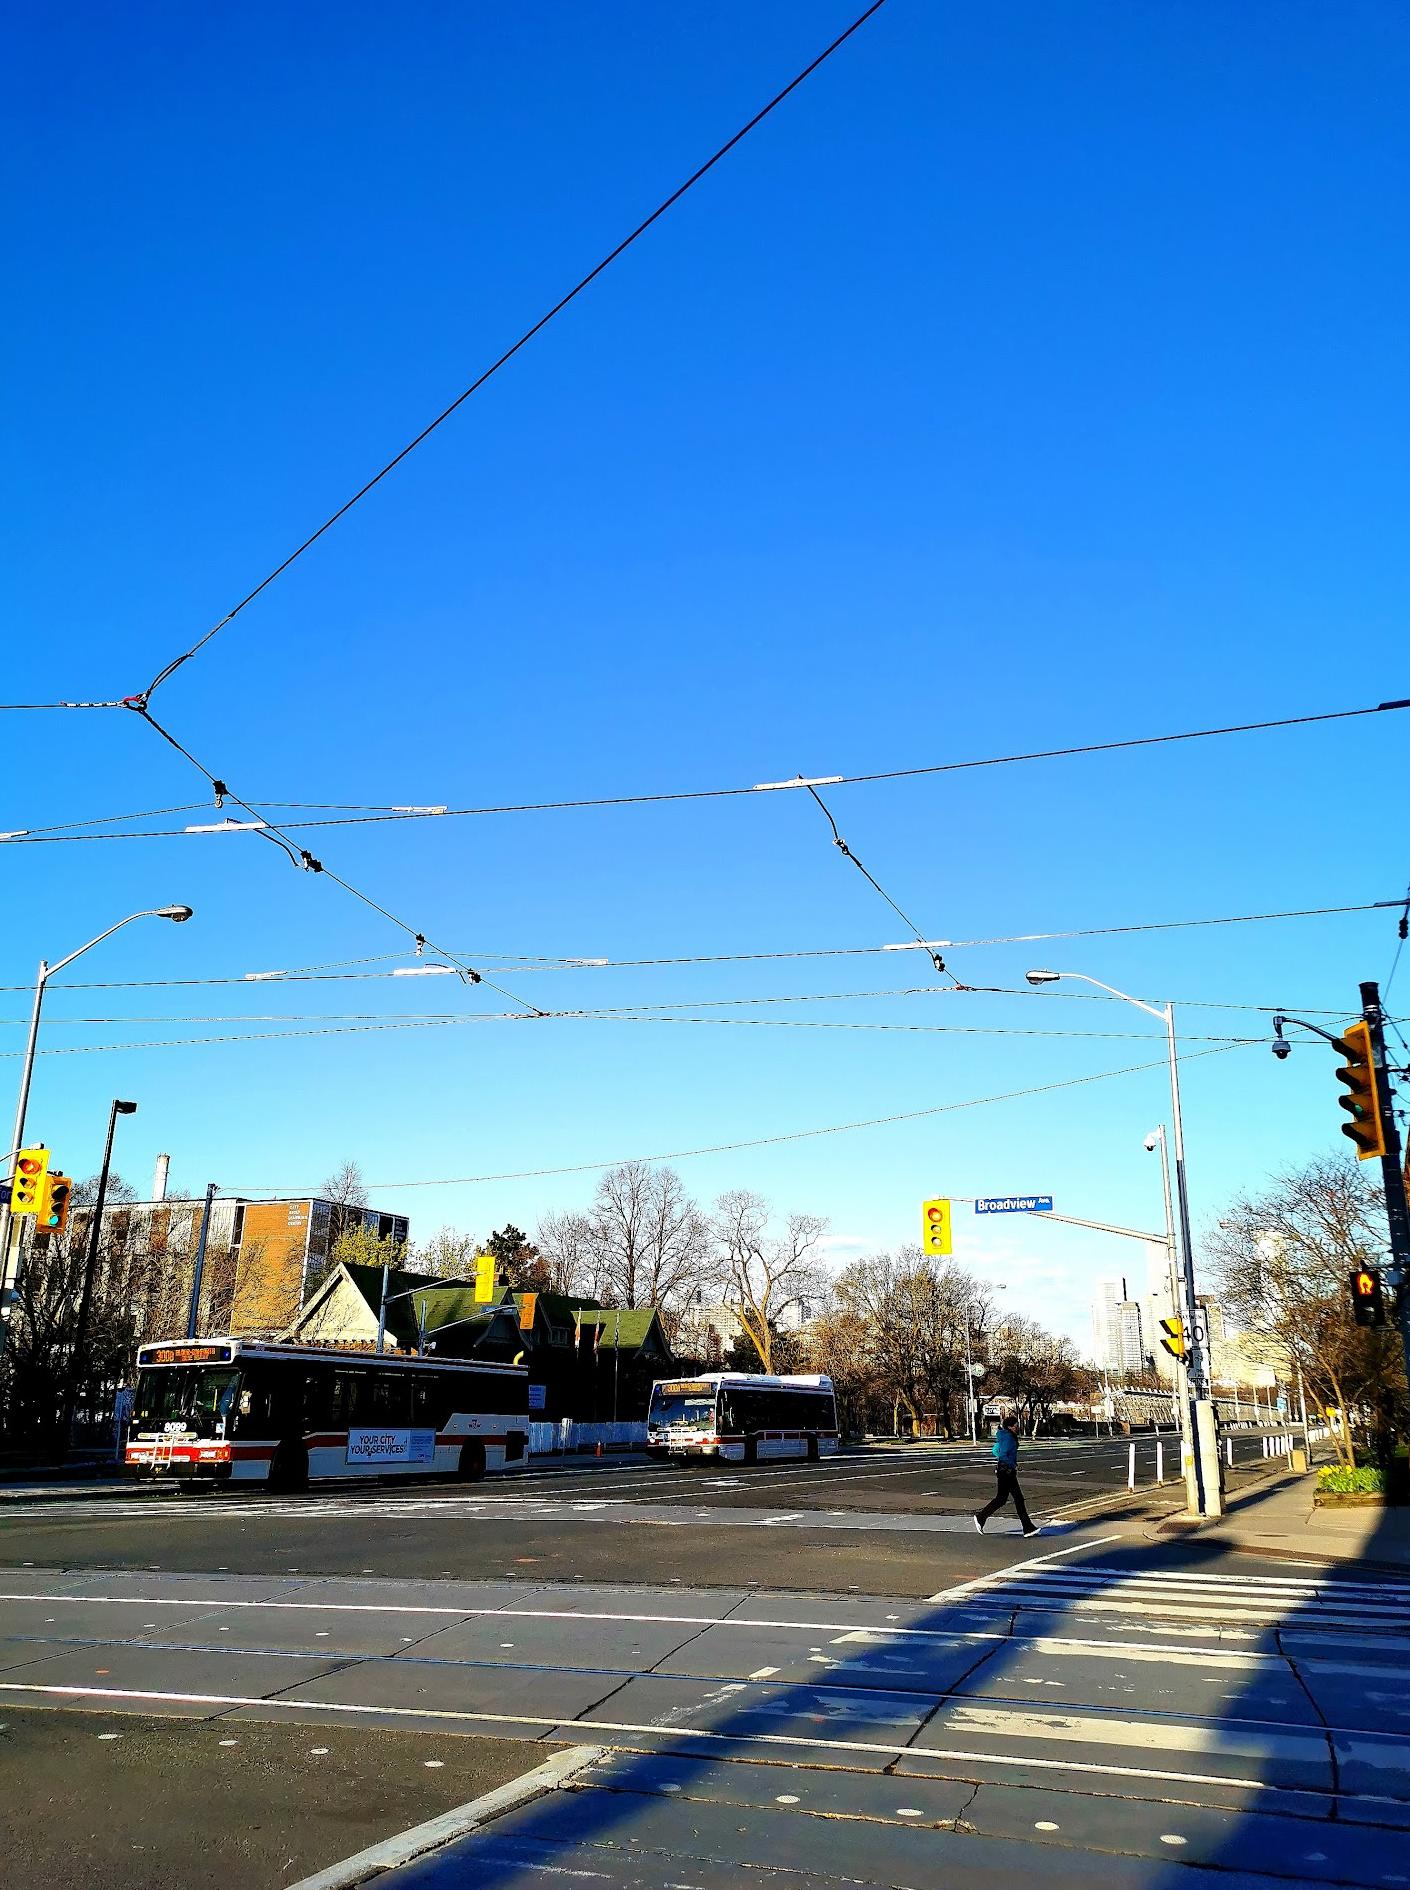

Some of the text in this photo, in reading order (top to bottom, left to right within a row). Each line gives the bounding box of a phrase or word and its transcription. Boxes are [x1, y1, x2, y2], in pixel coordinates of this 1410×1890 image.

[977, 1197, 1036, 1211] Broadview
[1183, 1325, 1204, 1342] 40
[164, 1422, 187, 1432] 8099
[359, 1433, 396, 1445] YOUR CITY
[350, 1444, 404, 1455] YOUR SERVICES
